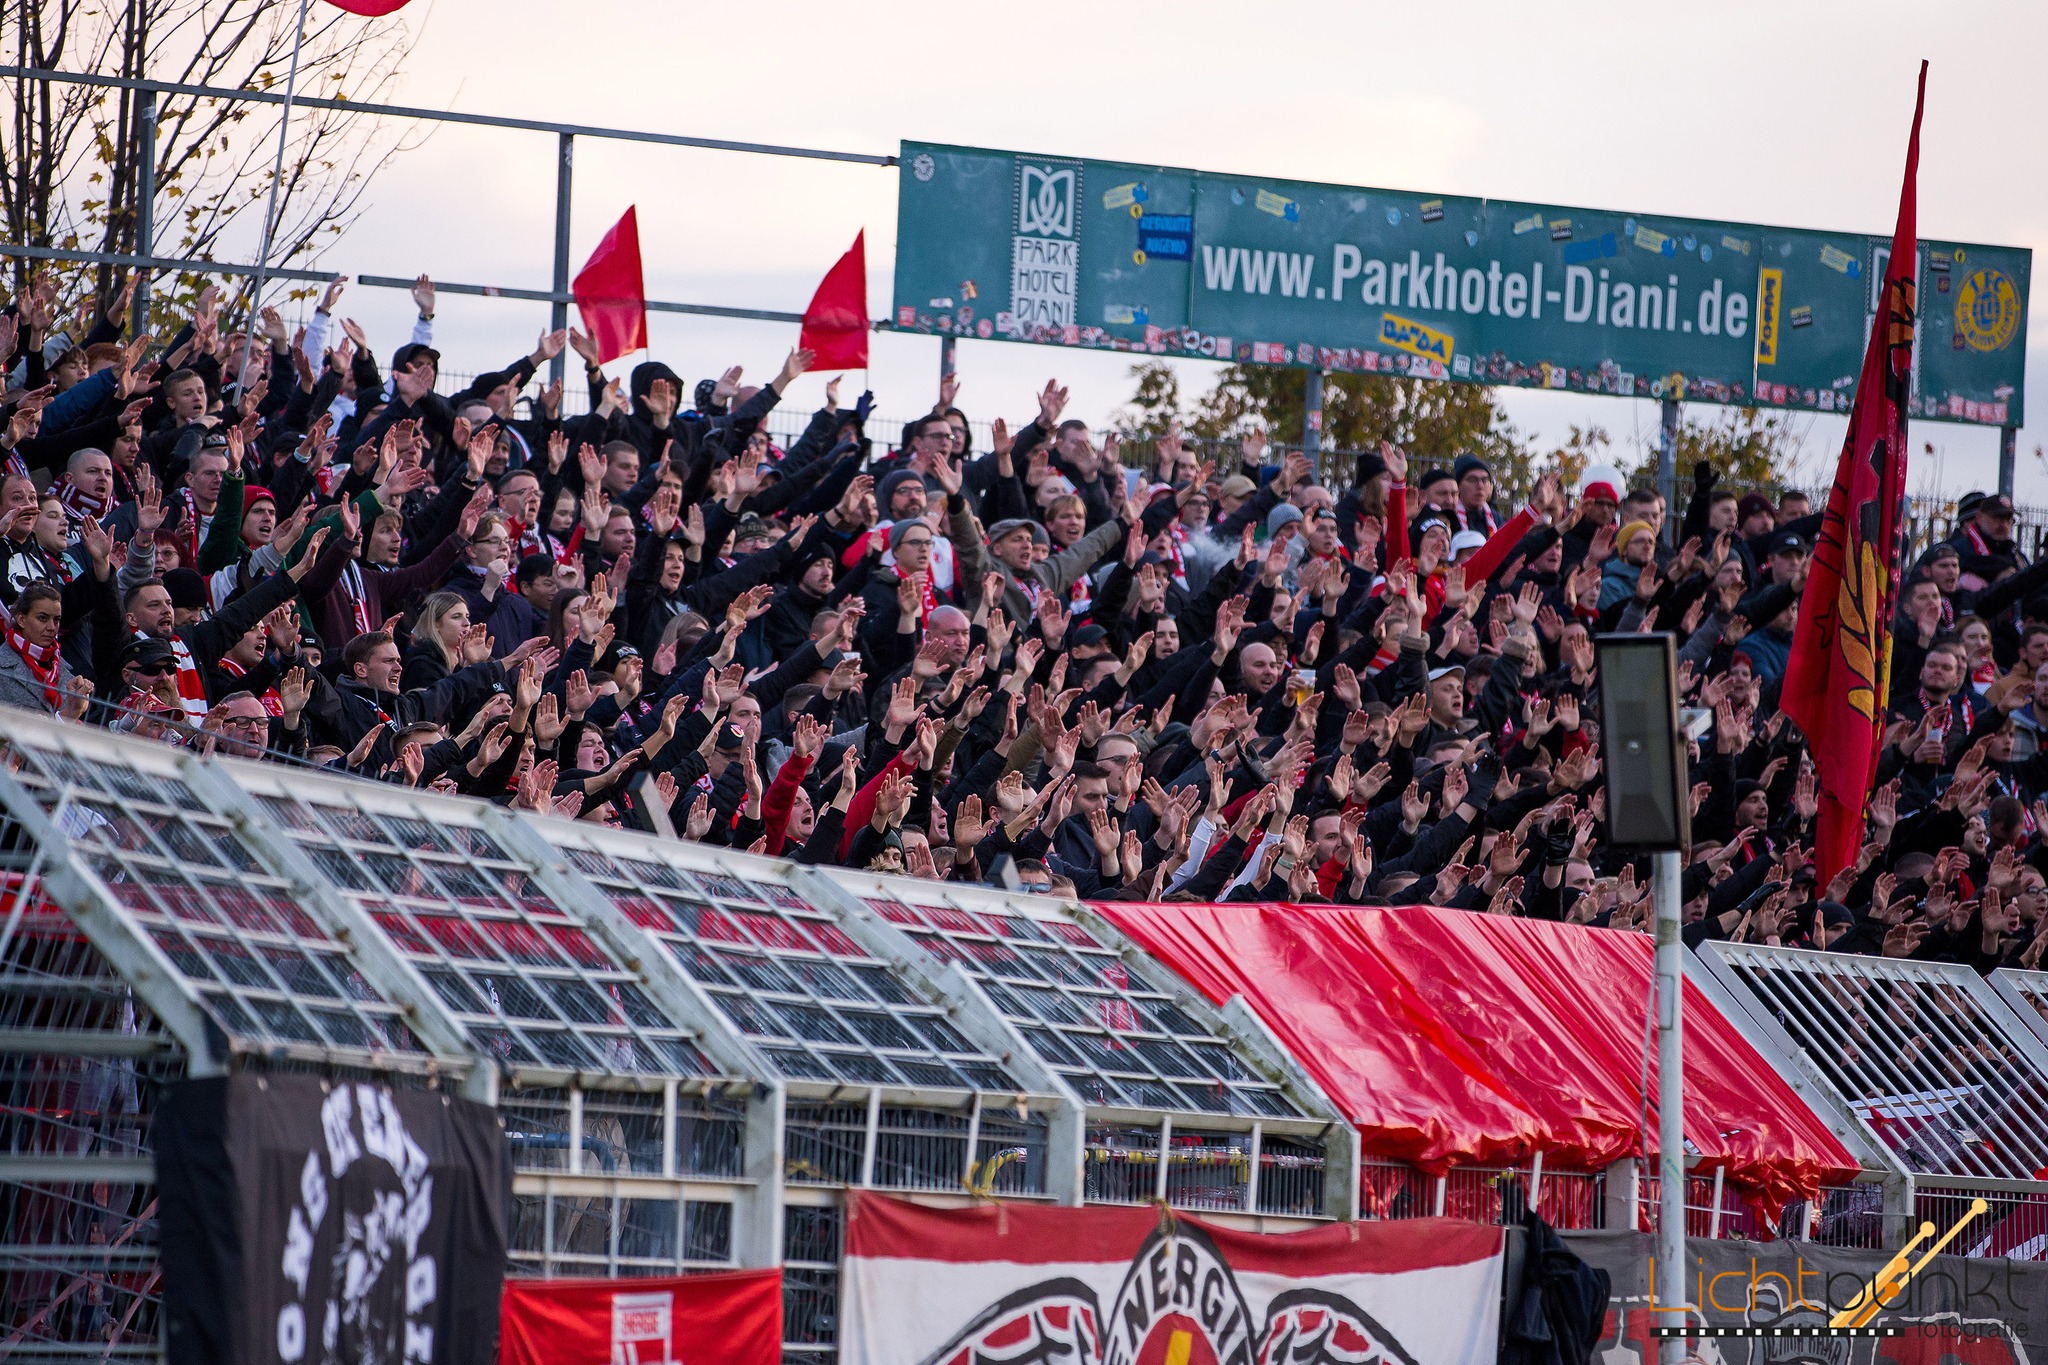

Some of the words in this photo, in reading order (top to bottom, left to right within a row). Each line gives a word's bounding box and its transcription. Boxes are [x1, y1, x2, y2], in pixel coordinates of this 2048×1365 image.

[1019, 239, 1073, 266] PARK
[1018, 268, 1071, 296] HOTEL
[1202, 243, 1749, 338] www.Parkhotel-Diani.de
[1016, 297, 1071, 324] DIANI
[221, 381, 244, 394] Cam
